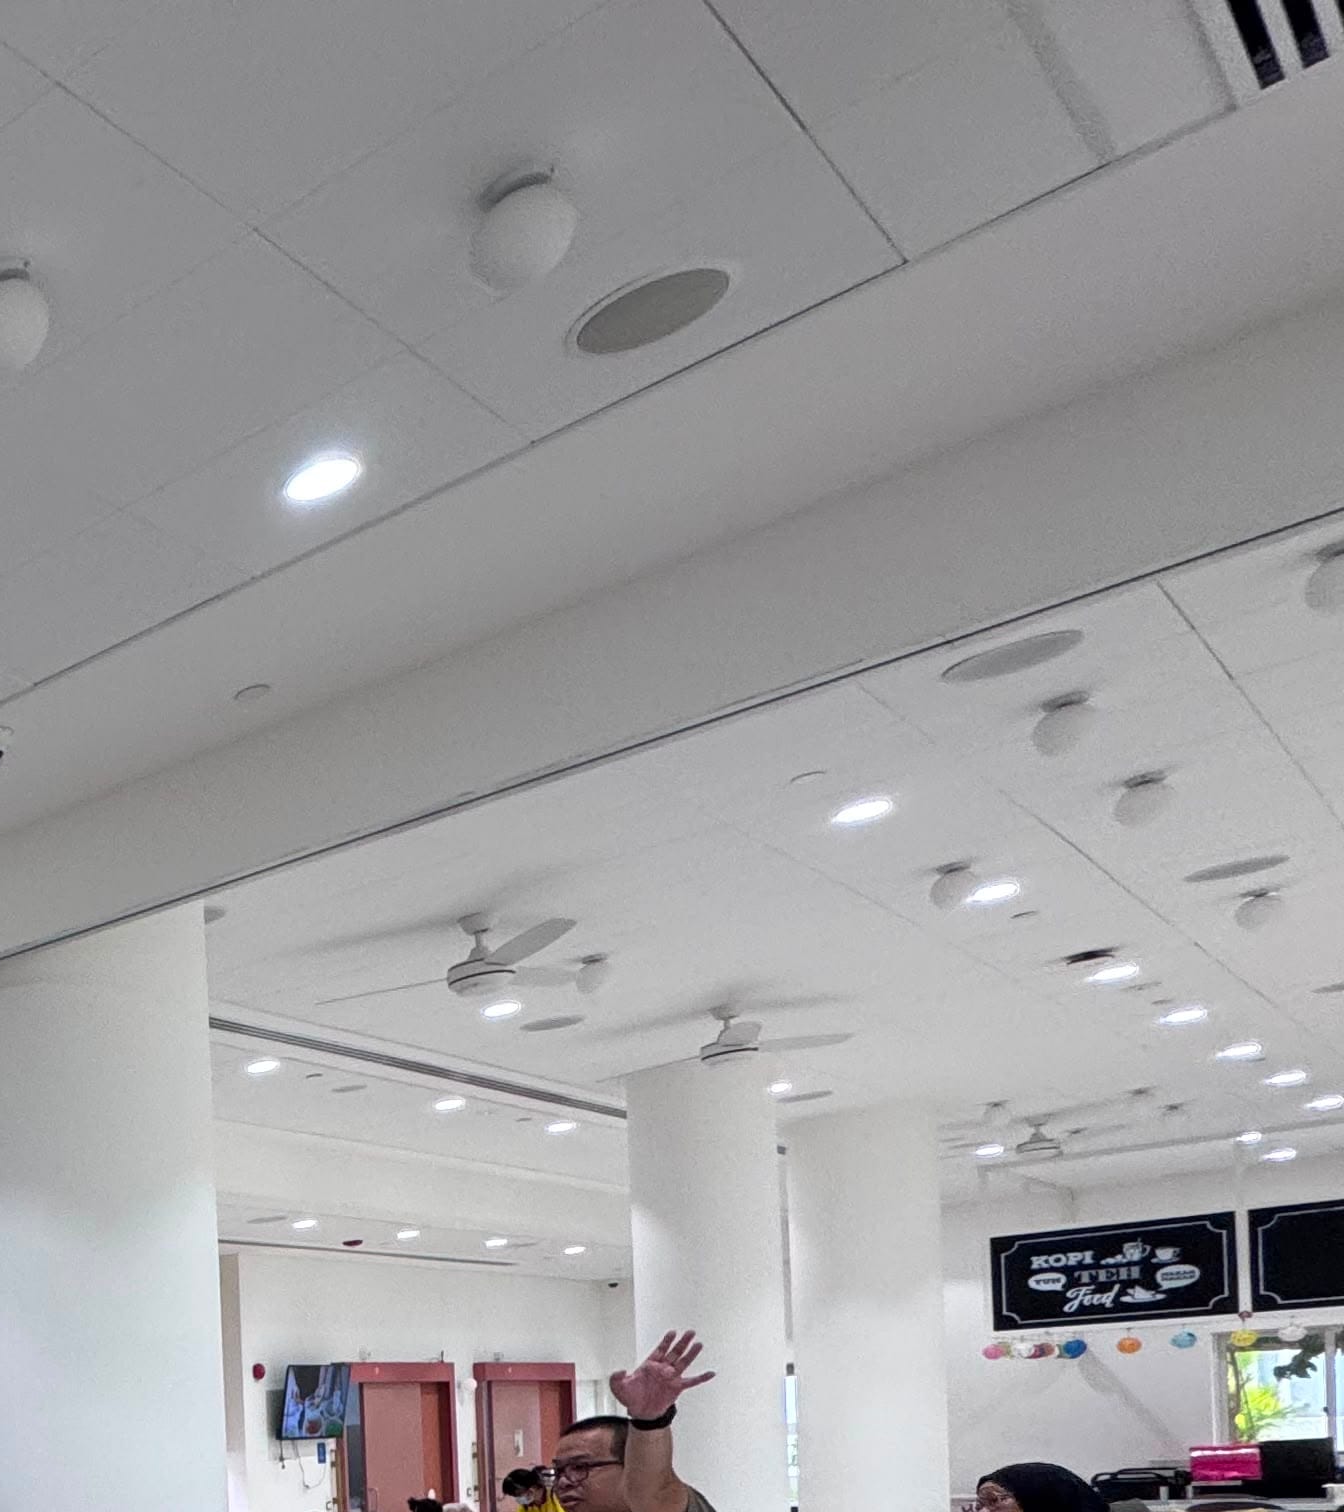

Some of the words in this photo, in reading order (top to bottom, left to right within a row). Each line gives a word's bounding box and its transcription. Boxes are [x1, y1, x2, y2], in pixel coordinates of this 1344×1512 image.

[1030, 1250, 1094, 1269] KOPI
[1074, 1266, 1141, 1283] TEH
[1063, 1284, 1121, 1313] Food
